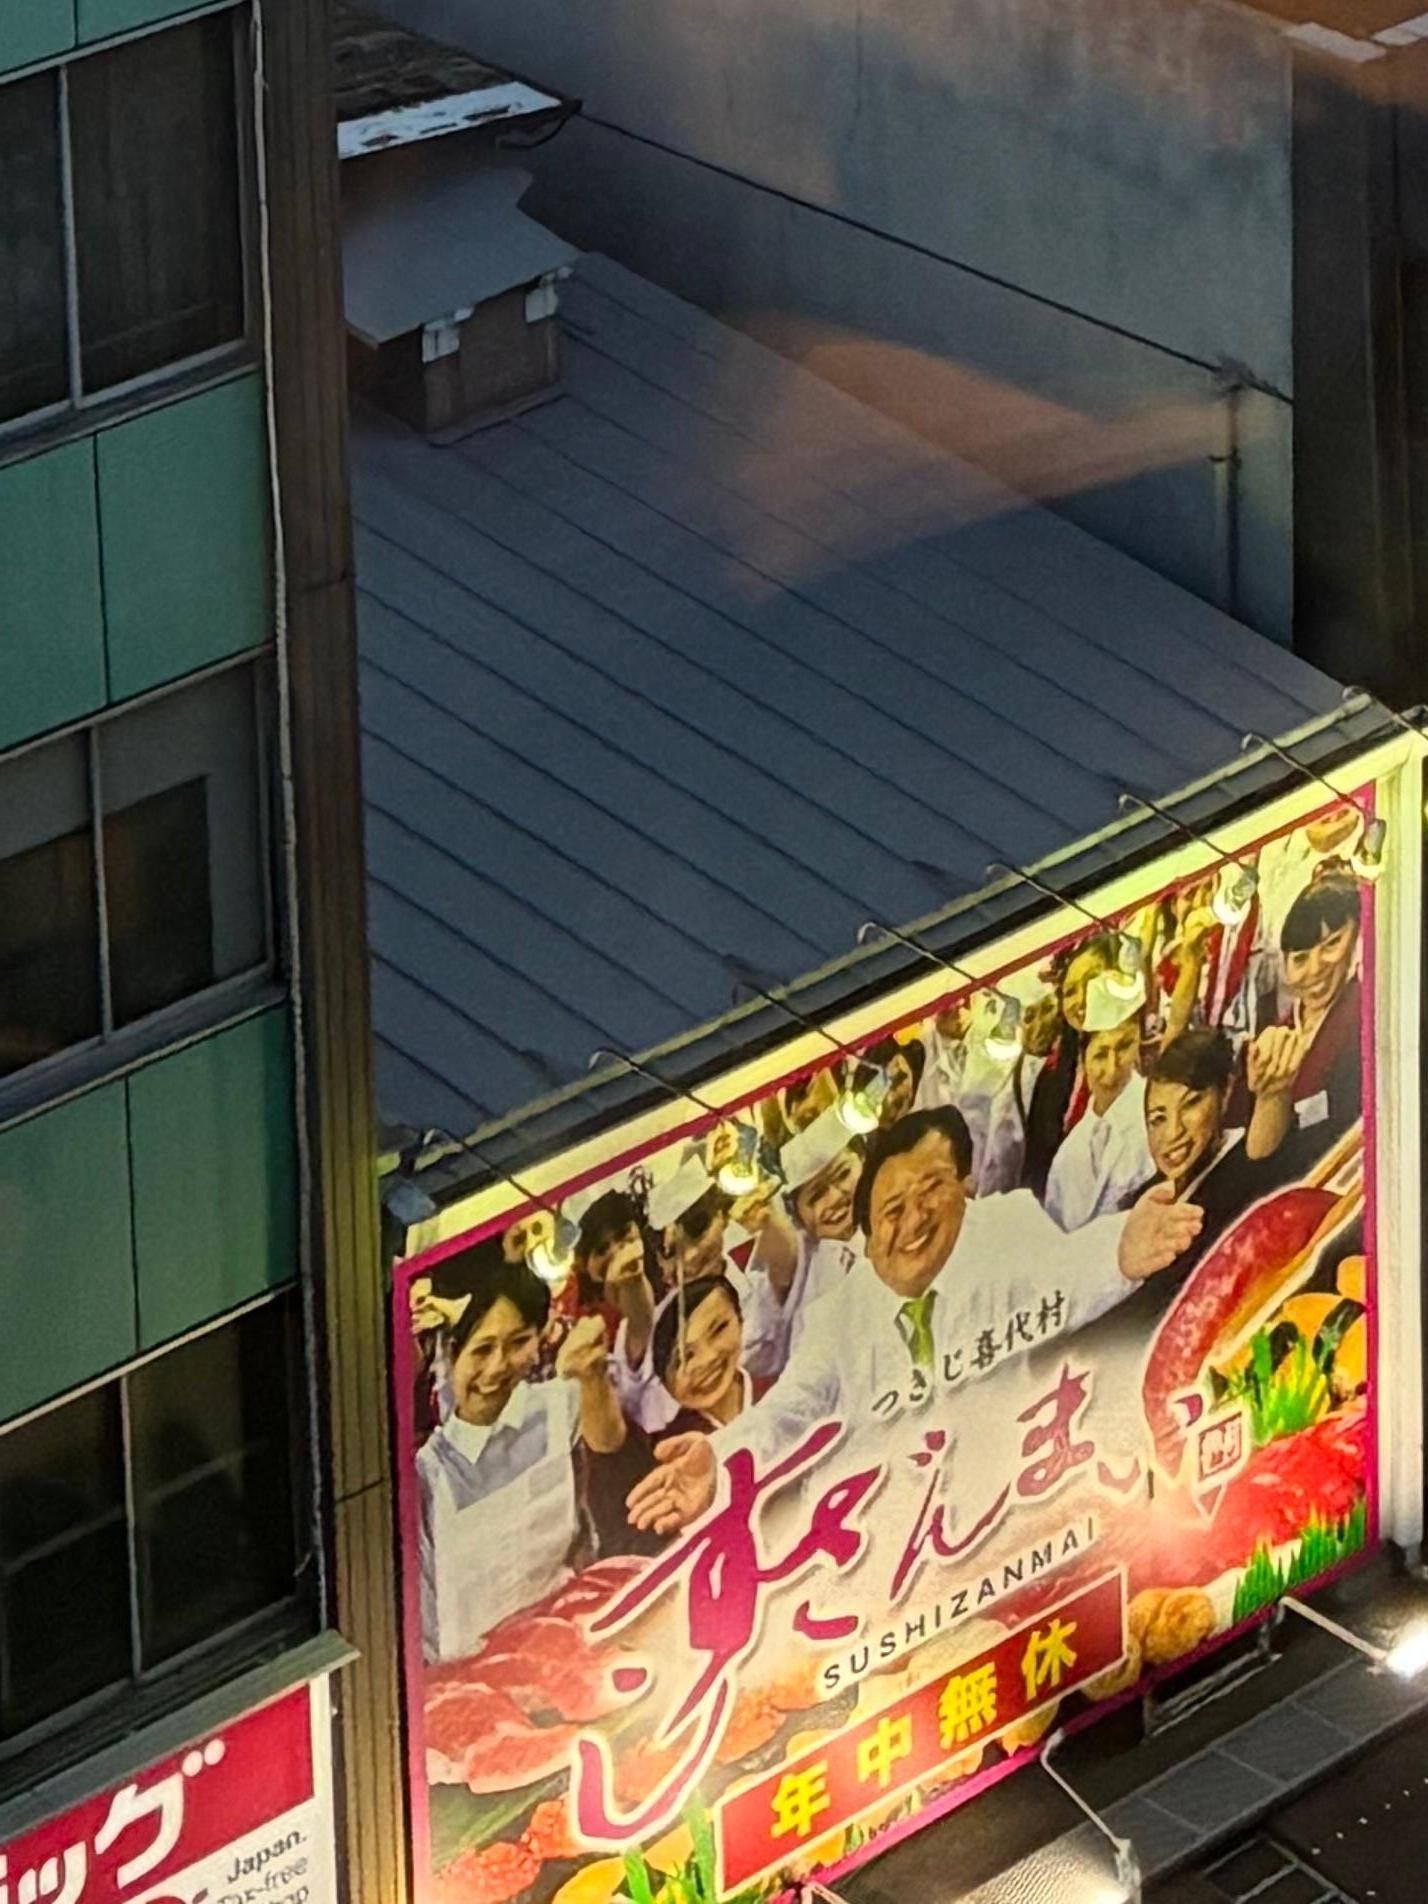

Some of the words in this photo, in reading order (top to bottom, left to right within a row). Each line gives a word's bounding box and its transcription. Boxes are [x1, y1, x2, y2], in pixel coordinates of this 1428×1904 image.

[871, 1290, 1065, 1411] つきじ喜代村
[824, 1517, 1096, 1690] SUSHIZANMAI
[770, 1618, 1079, 1839] 年中無休
[0, 1739, 226, 1904] ッグ
